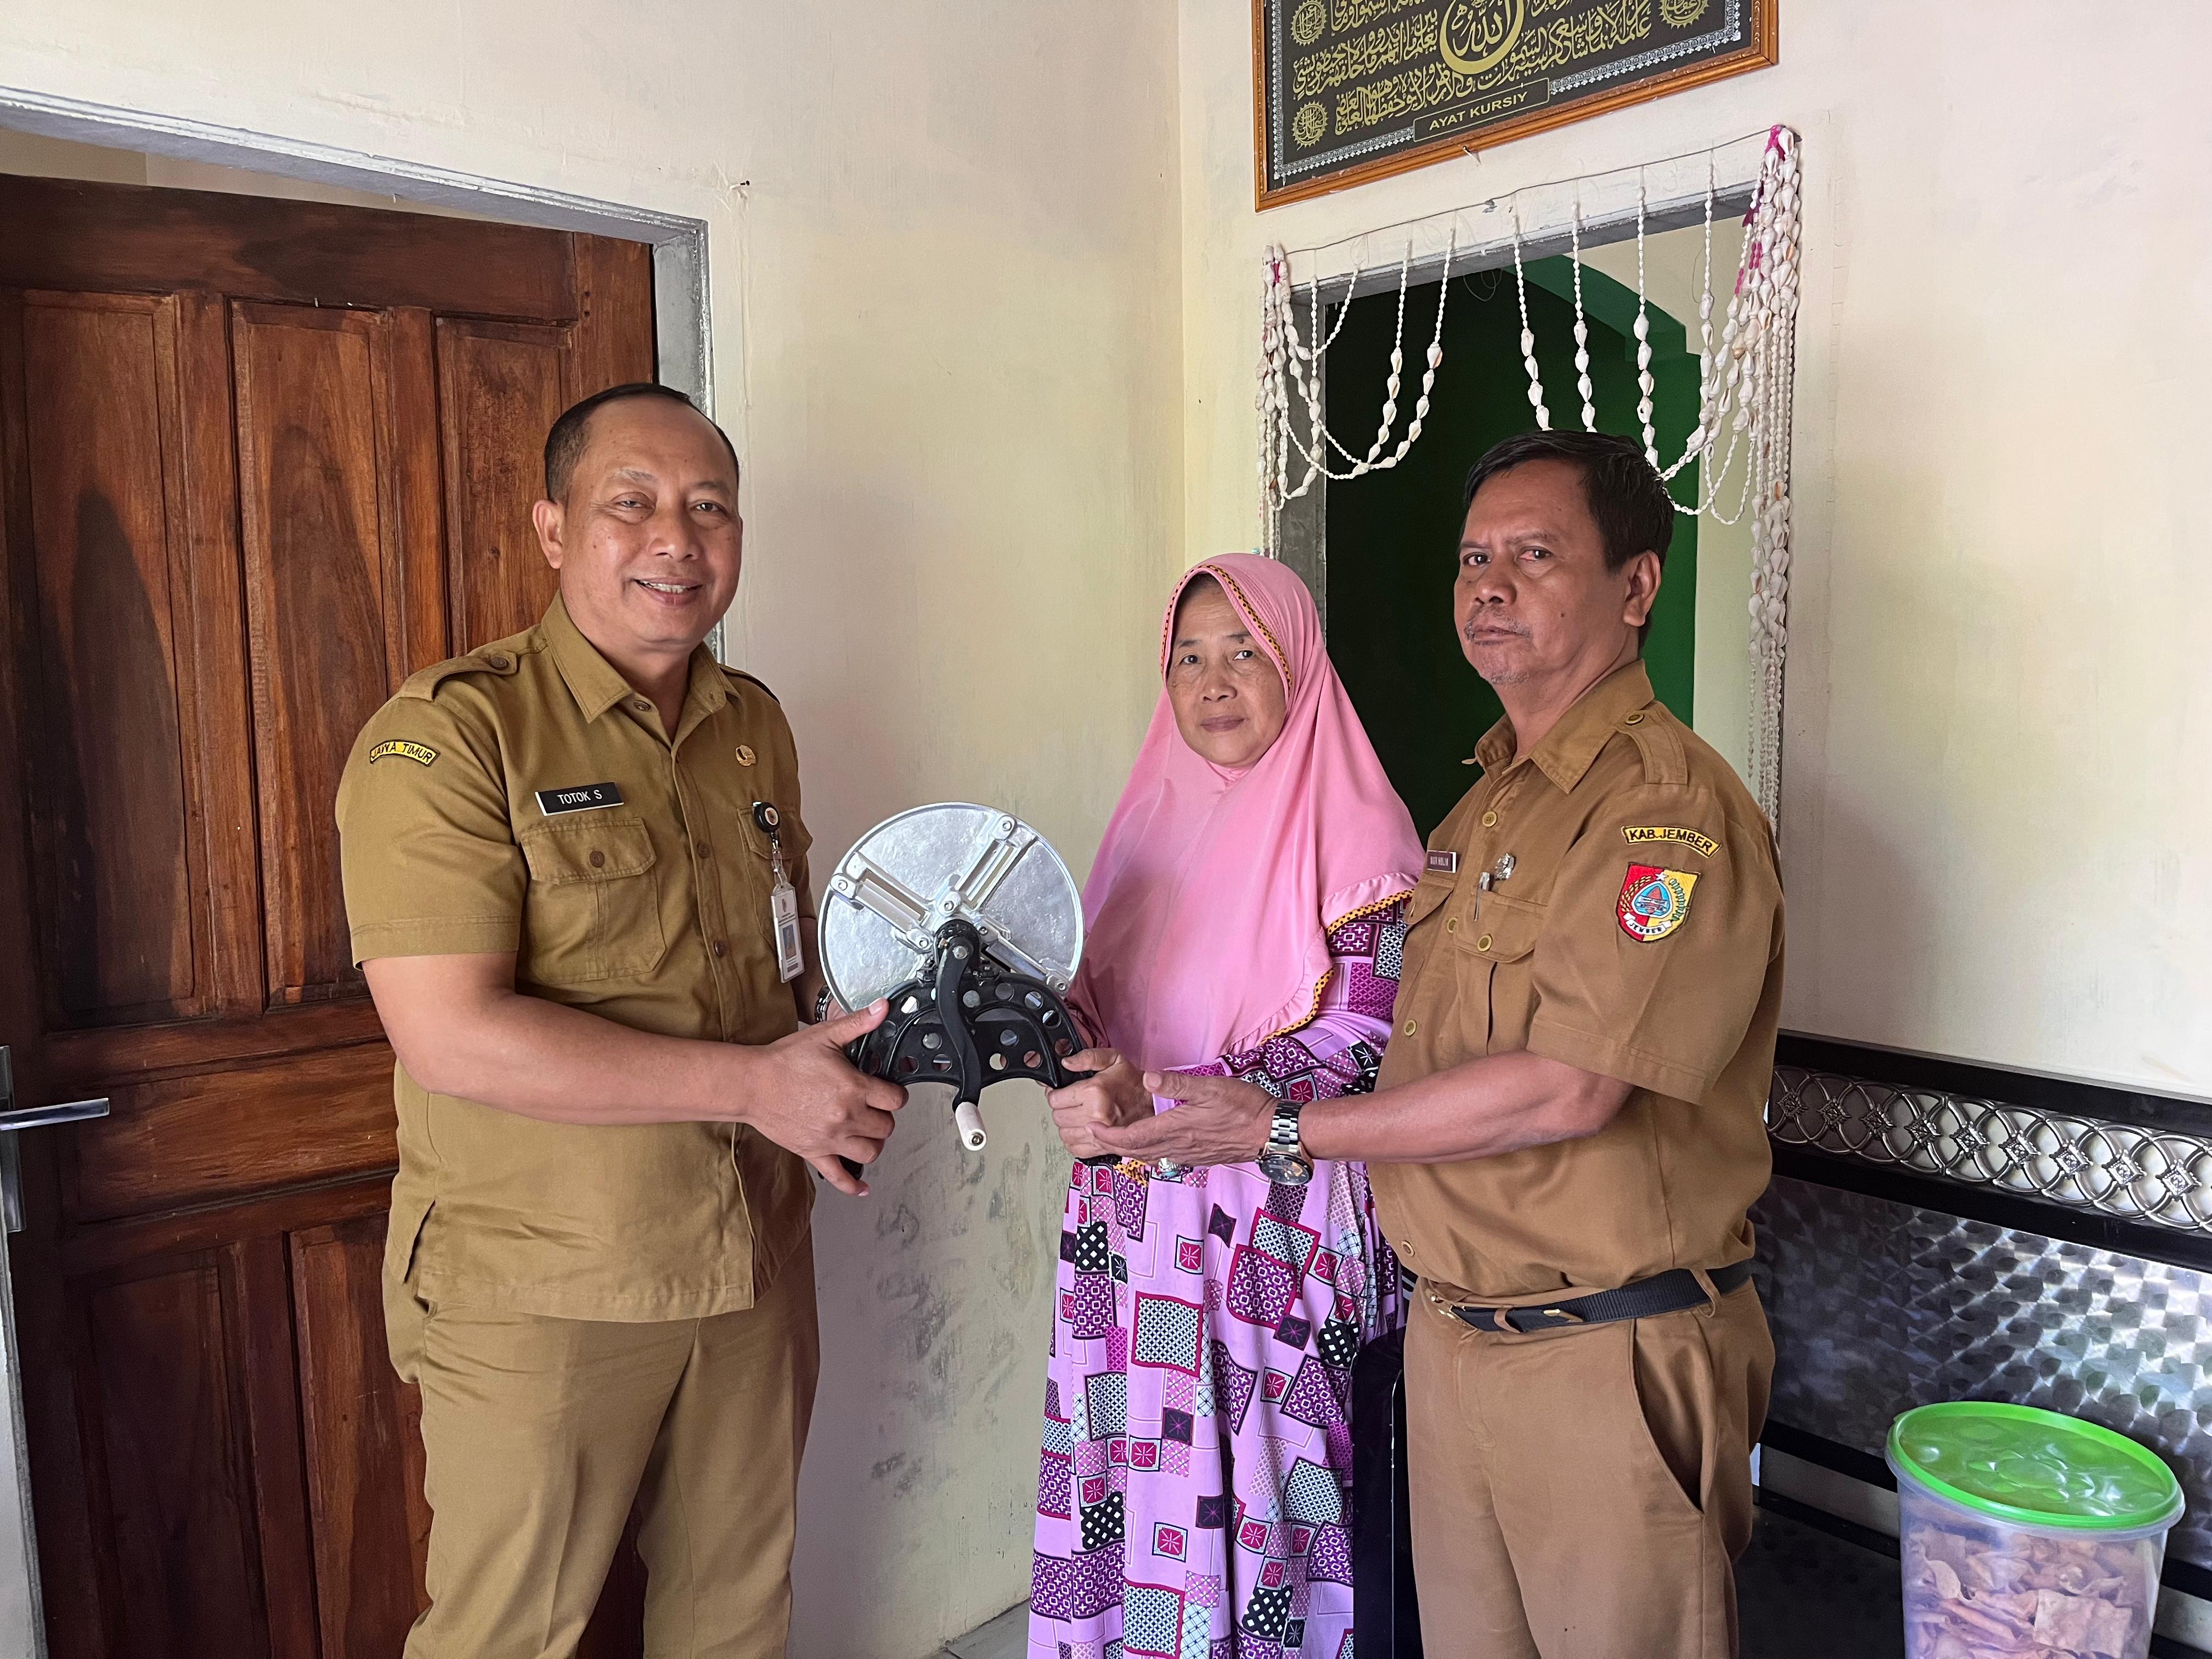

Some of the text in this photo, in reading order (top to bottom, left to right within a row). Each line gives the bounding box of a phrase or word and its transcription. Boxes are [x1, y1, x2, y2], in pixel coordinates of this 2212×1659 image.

[1429, 91, 1528, 131] AYAT KURSIY
[370, 741, 433, 763] JAWA TIMUR
[557, 789, 602, 805] TOTOK S
[1629, 922, 1662, 934] JEMBER
